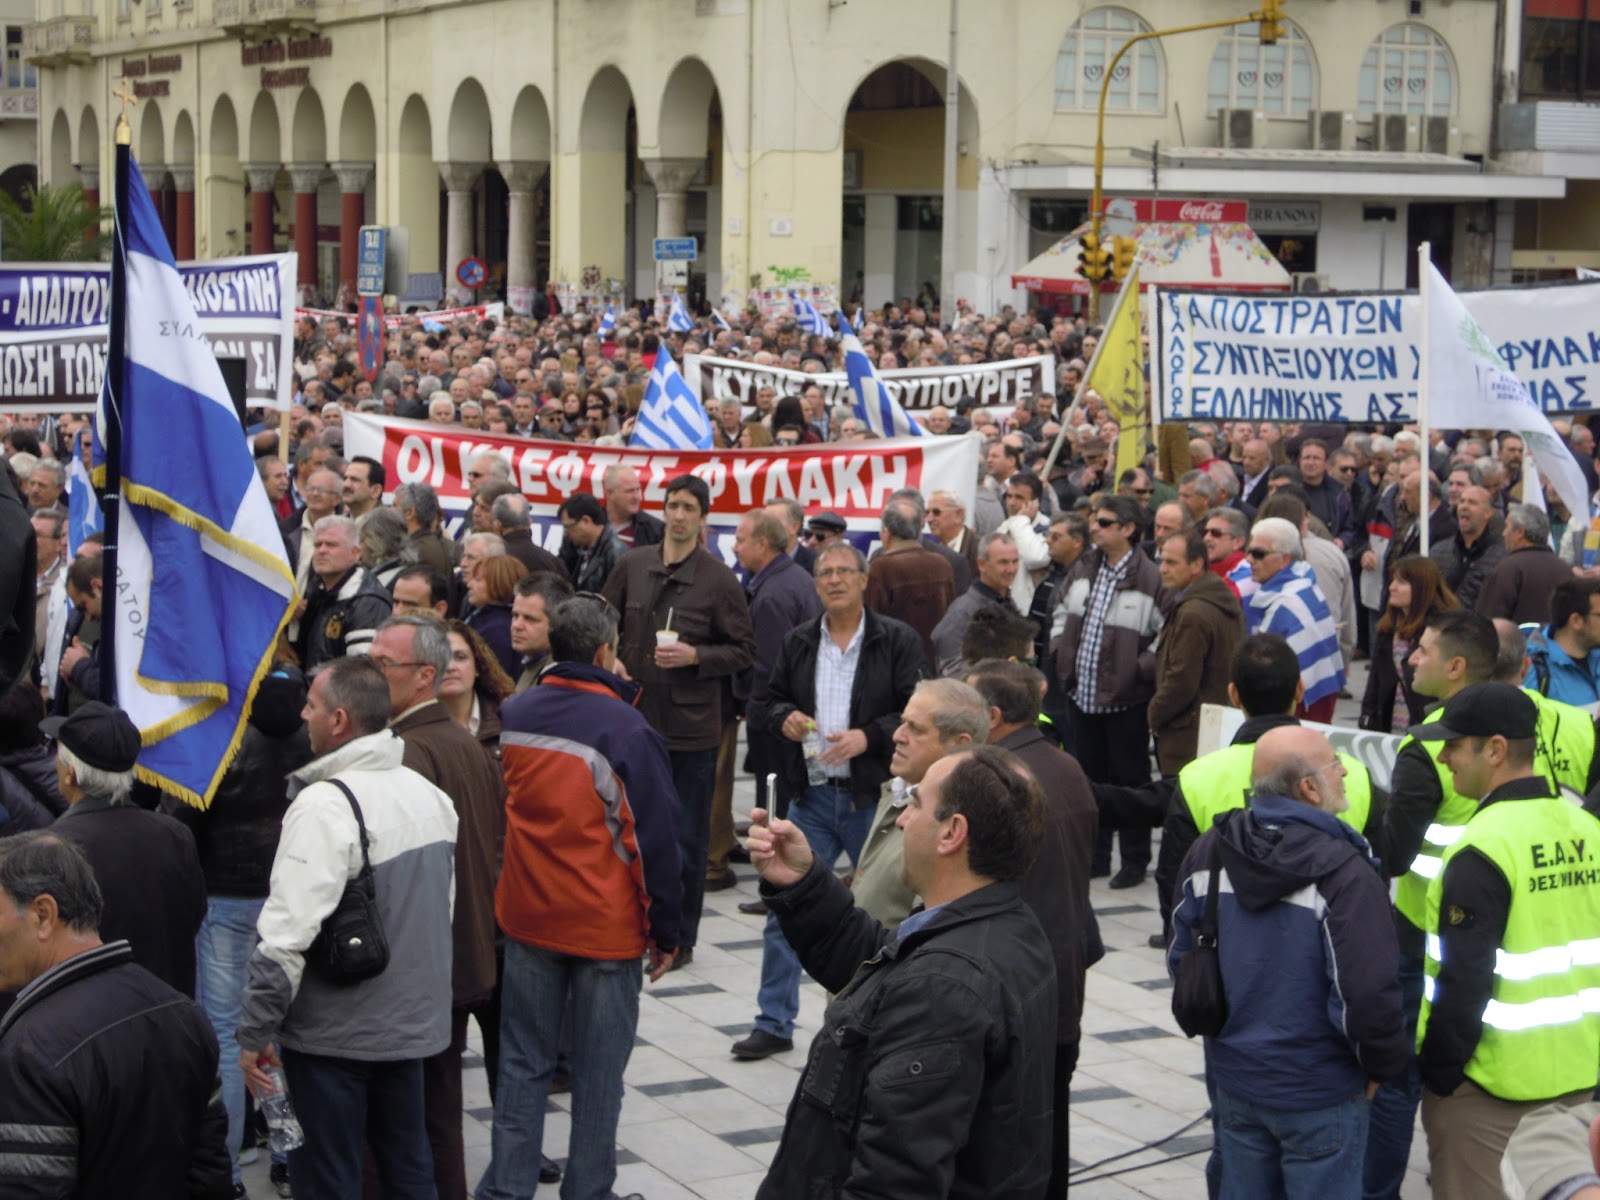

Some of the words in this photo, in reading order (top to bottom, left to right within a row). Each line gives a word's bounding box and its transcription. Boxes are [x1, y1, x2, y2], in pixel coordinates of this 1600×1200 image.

[1179, 202, 1224, 221] Coca-Cola
[180, 266, 279, 312] ΑΙΟΣΥΝΗ
[1188, 297, 1402, 334] ΑΠΟΣΤΡΑΤΩΝ
[0, 344, 54, 396] ΩΣΗ
[1193, 341, 1398, 381] ΣΥΝΤΑΞΙΟΥΧΩΝ
[1192, 387, 1348, 421] ΕΛΛΗΝΙΚΗΣ
[396, 435, 445, 487] ΟΙ
[689, 455, 907, 509] ΦΥΛΑΚΗ
